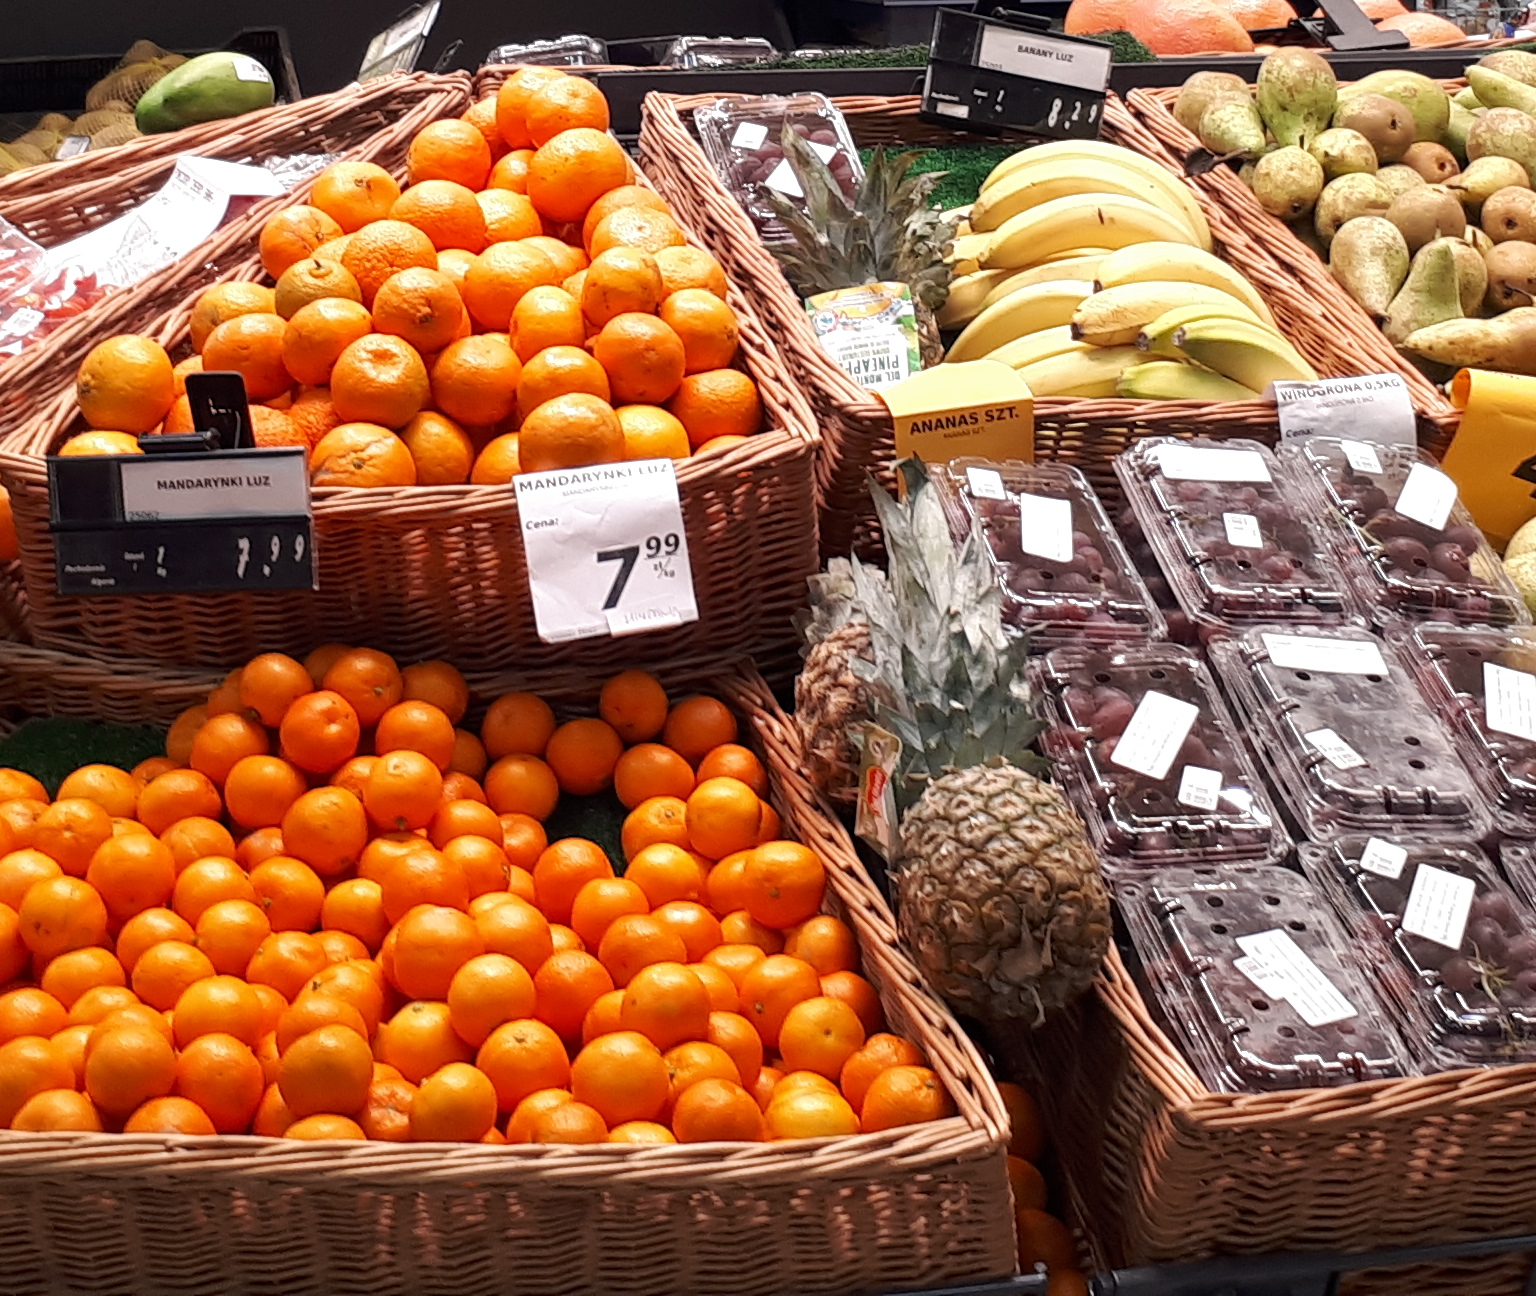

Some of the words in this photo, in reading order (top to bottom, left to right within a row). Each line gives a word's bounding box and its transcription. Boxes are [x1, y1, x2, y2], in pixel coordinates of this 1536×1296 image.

[1017, 44, 1053, 59] BANANY
[1056, 50, 1074, 63] LUZ
[910, 411, 979, 435] ANANAS
[984, 406, 1019, 423] SZT.
[156, 477, 243, 491] MANDARYNKI
[246, 475, 272, 488] LUZ
[519, 469, 633, 493] MANDARYNKI
[525, 517, 559, 531] Cena:
[596, 545, 640, 611] 7
[645, 532, 680, 557] 99
